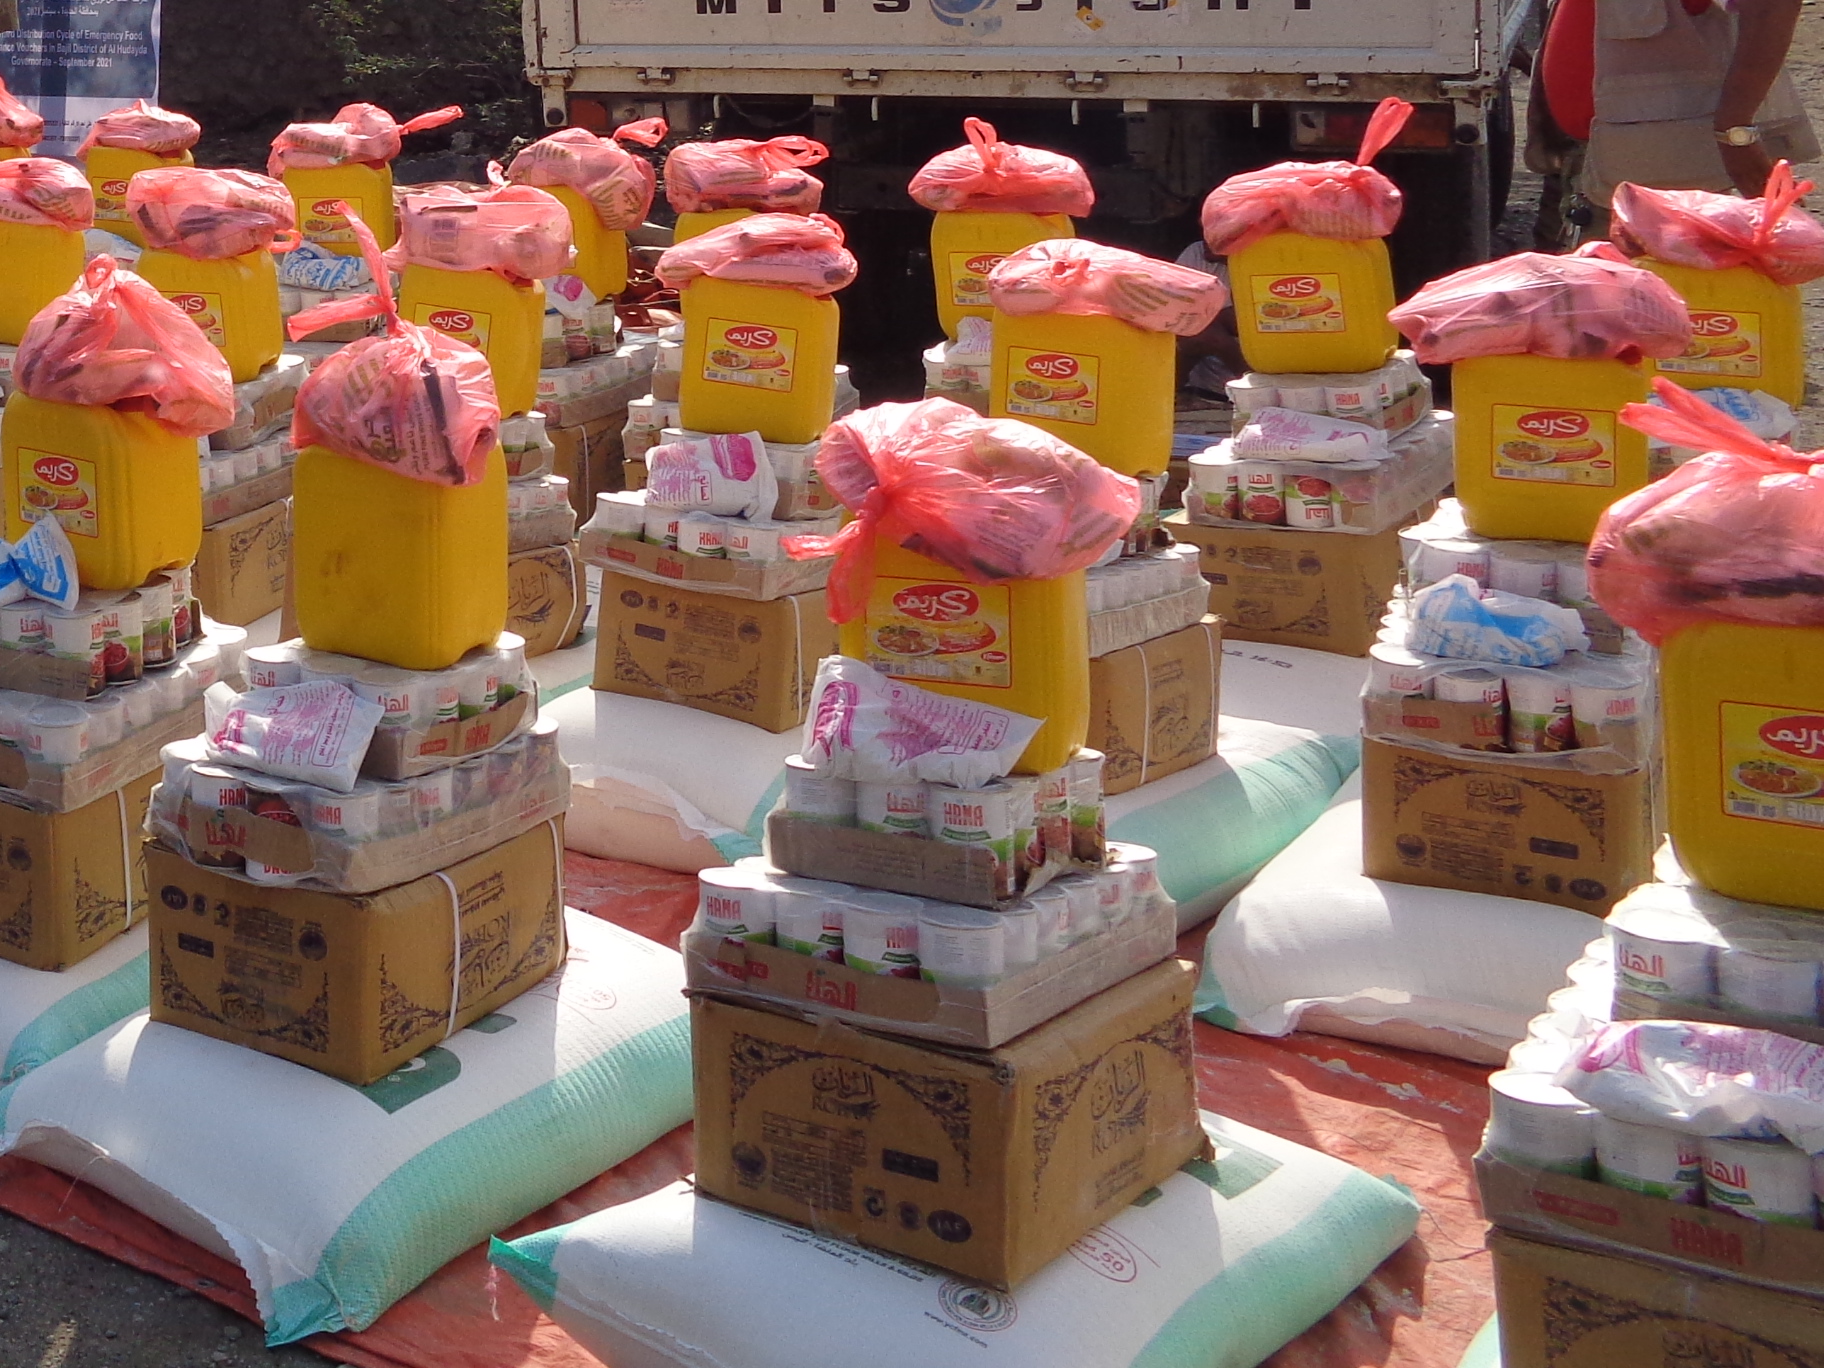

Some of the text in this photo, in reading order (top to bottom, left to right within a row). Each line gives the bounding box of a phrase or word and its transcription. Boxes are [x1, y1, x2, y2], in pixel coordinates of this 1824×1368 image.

[16, 29, 143, 43] Distribution Cycle of Emergency Food
[16, 43, 48, 53] Vouchers
[72, 43, 98, 53] District
[99, 43, 107, 53] of
[107, 43, 116, 53] Al
[116, 43, 148, 57] Hudayda
[11, 56, 113, 68] Governorate September 2021
[1272, 279, 1316, 297] كريم
[431, 314, 470, 330] كريم
[728, 329, 774, 347] كريم
[1028, 357, 1074, 377] كريم
[1334, 393, 1361, 406] HANA
[1521, 413, 1582, 436] كريم
[37, 462, 75, 482] كريم
[1248, 473, 1273, 485] الهنا
[898, 588, 972, 619] كريم
[943, 801, 984, 827] HANA
[706, 895, 742, 921] HANA
[1618, 943, 1664, 979] الهنا
[805, 968, 857, 1012] الهنا
[1101, 1250, 1126, 1274] 50
